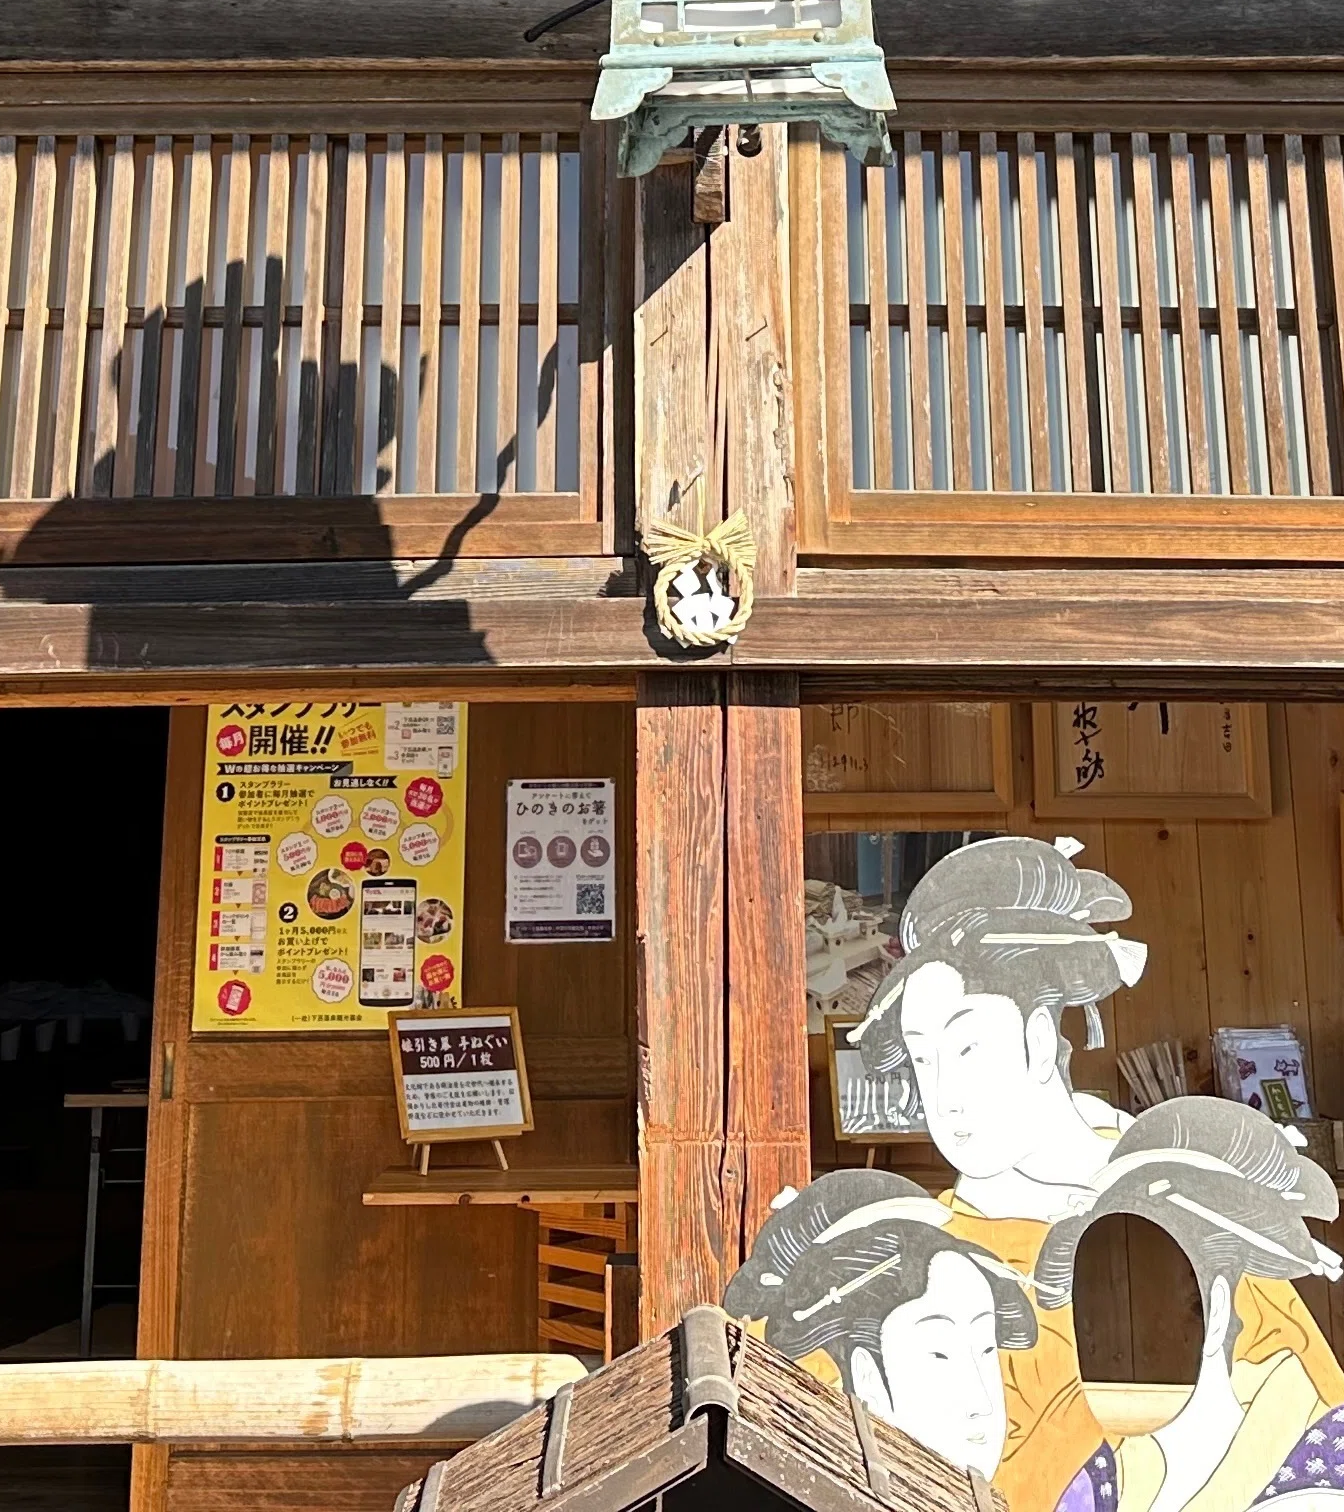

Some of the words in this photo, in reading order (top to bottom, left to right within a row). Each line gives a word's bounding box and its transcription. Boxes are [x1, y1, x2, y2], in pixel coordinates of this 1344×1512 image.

[218, 731, 245, 750] 毎月
[248, 724, 336, 756] 開催!!
[240, 780, 291, 788] スタンプラリー
[238, 798, 309, 808] ポイントプレゼント!
[517, 800, 606, 816] ひのきのお箸
[276, 947, 349, 958] ポイントプレゼント!
[318, 970, 350, 983] 5,000
[458, 1034, 508, 1052] 手ぬぐい
